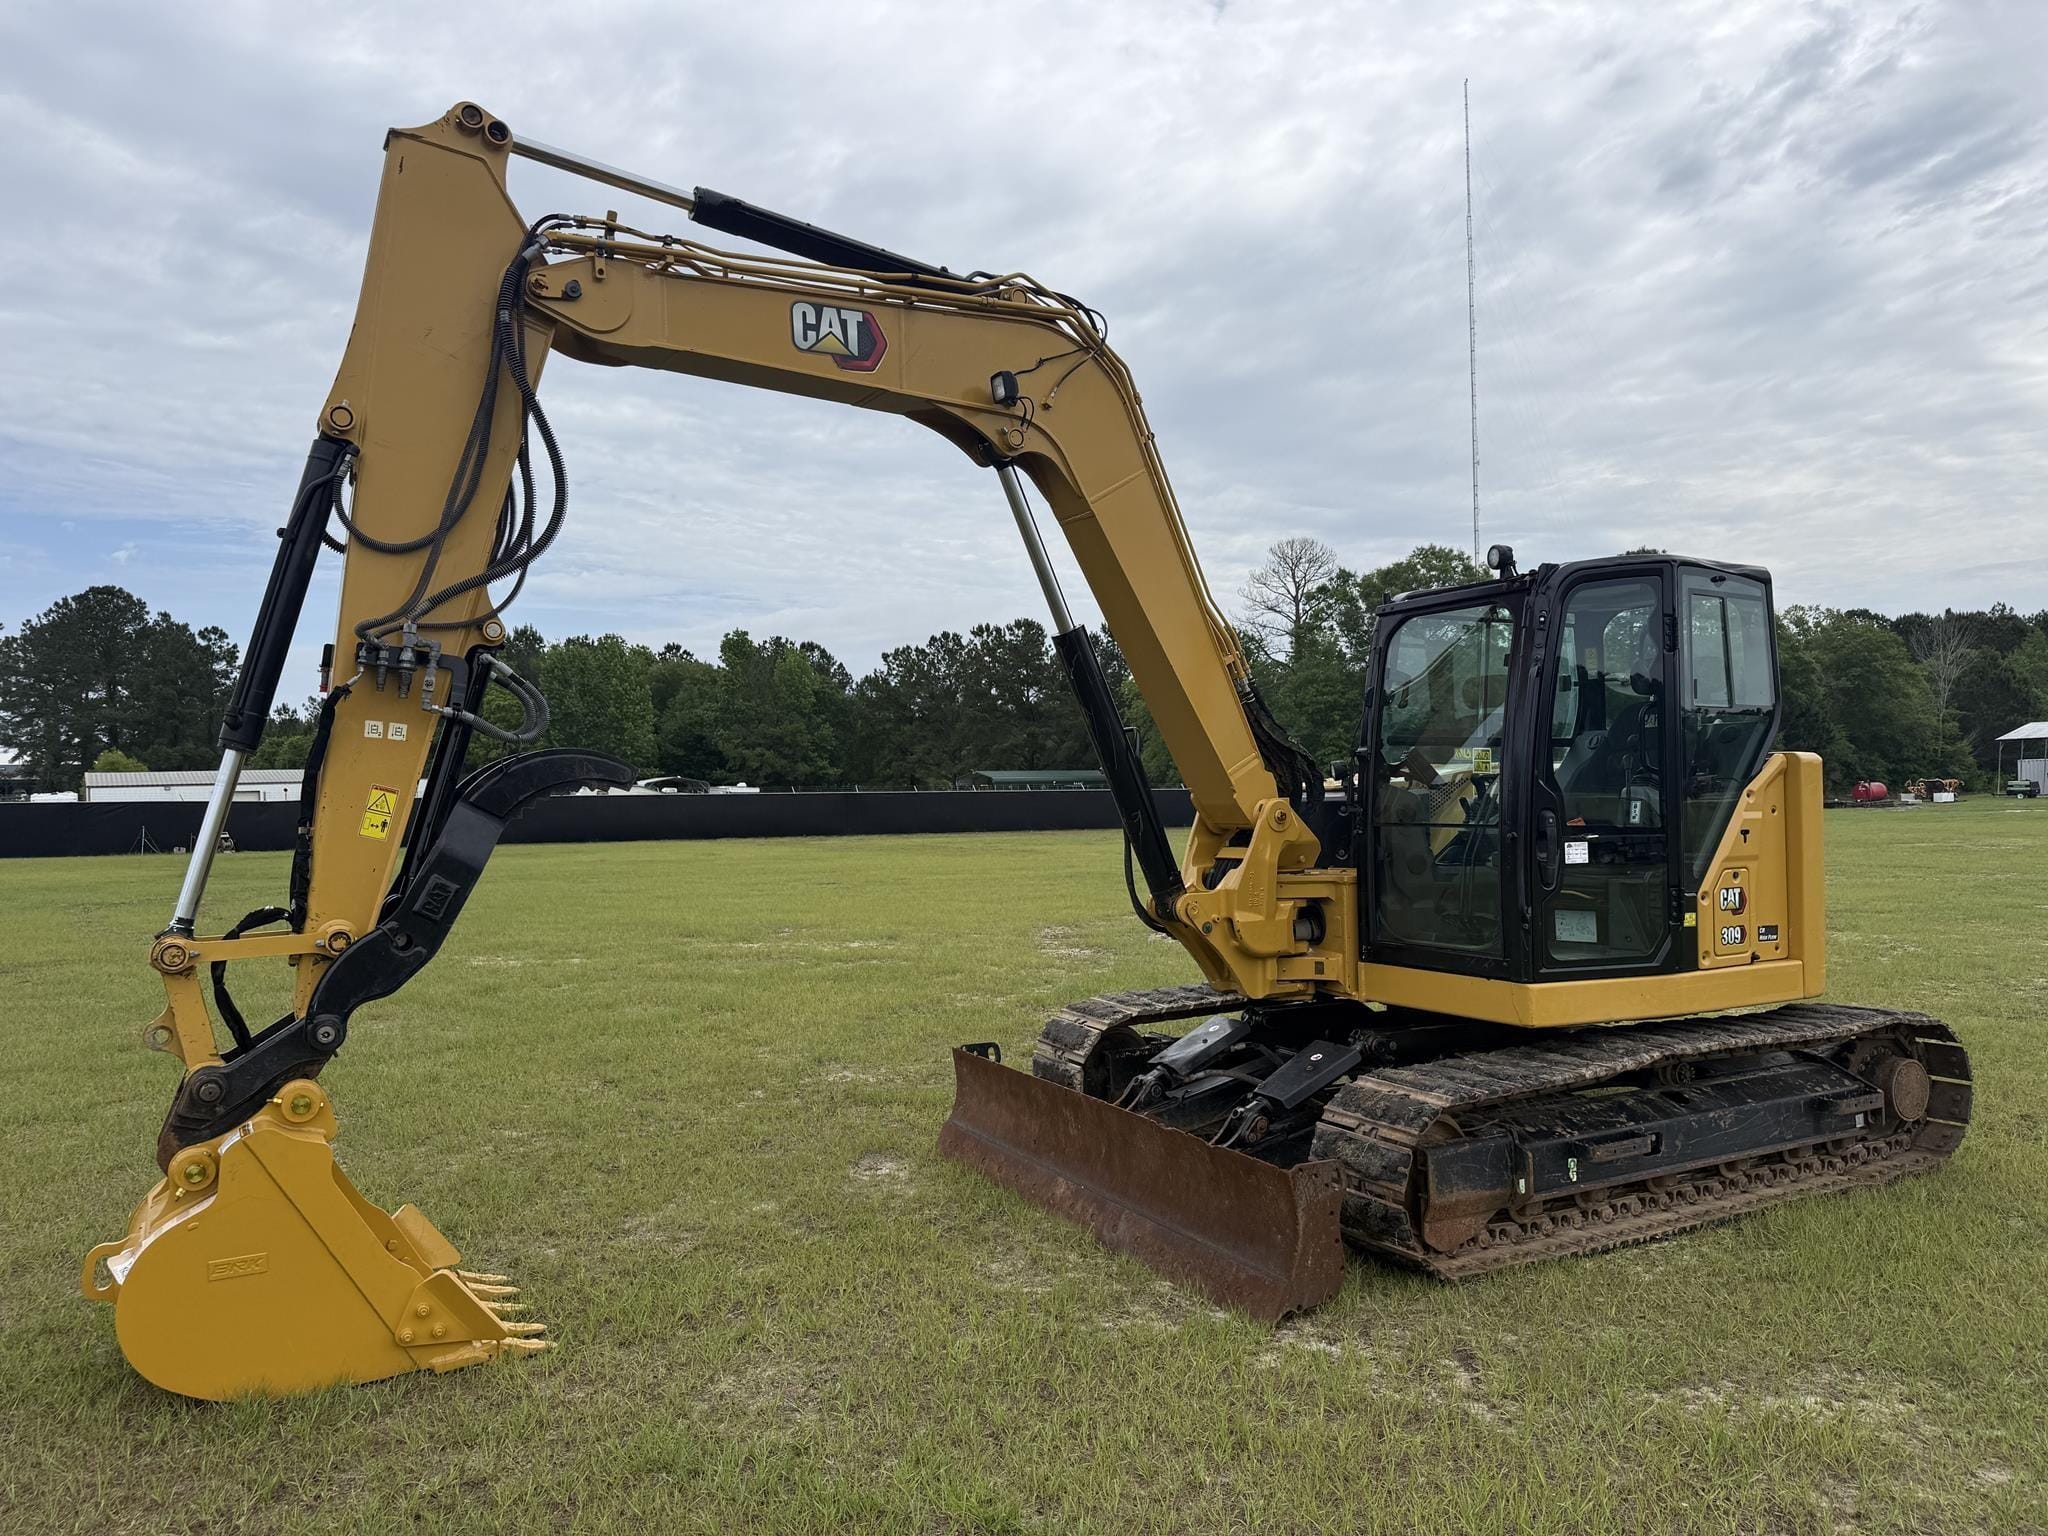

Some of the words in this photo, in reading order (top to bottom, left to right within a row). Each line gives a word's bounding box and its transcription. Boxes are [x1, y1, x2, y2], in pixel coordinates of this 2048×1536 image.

[792, 302, 863, 357] CAT
[1720, 887, 1741, 910] CAT
[1721, 926, 1741, 945] 309
